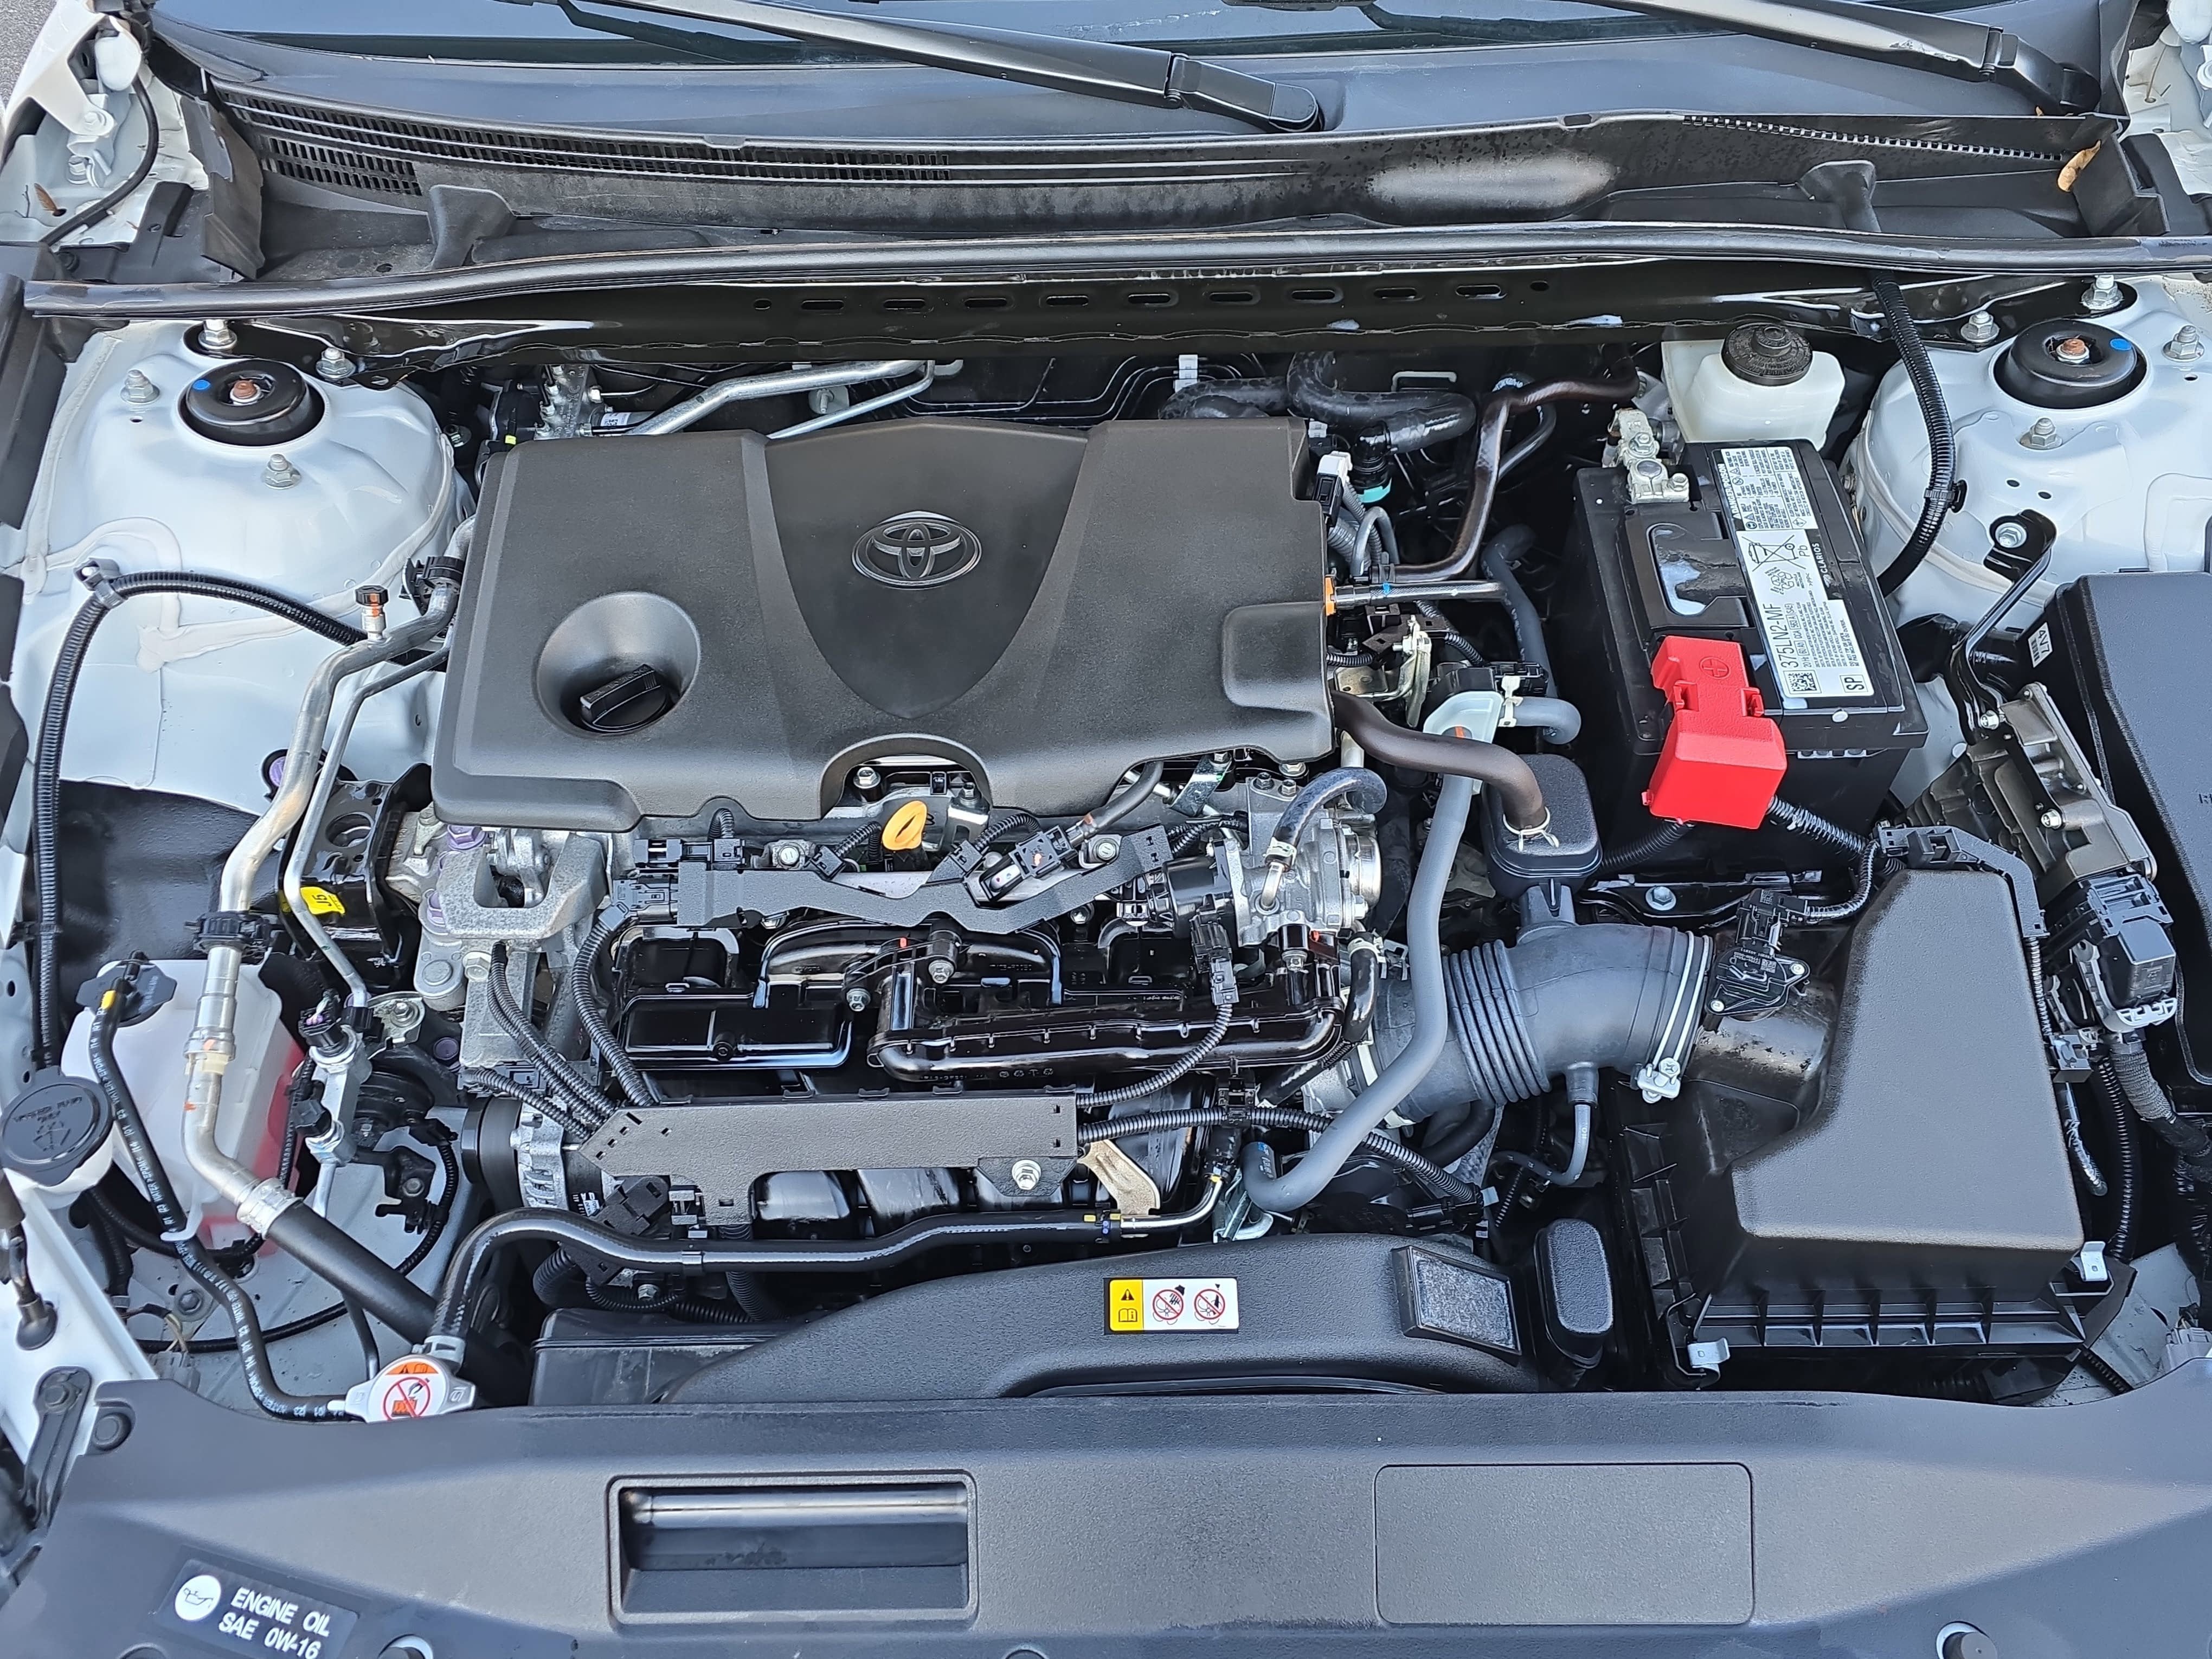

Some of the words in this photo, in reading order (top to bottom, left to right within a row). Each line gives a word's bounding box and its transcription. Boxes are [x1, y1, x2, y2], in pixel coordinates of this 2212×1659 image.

[1718, 464, 1739, 513] DANGER/POISON
[1796, 545, 1811, 556] Pb
[1812, 543, 1828, 573] CLARIOS
[1763, 603, 1799, 667] 375LN2-MF
[2037, 630, 2050, 653] 4V7
[1844, 677, 1864, 690] SP
[312, 895, 332, 906] J5
[230, 1587, 299, 1624] ENGINE
[303, 1611, 330, 1637] OIL
[218, 1612, 259, 1640] SAE
[264, 1627, 321, 1659] 0W-16
